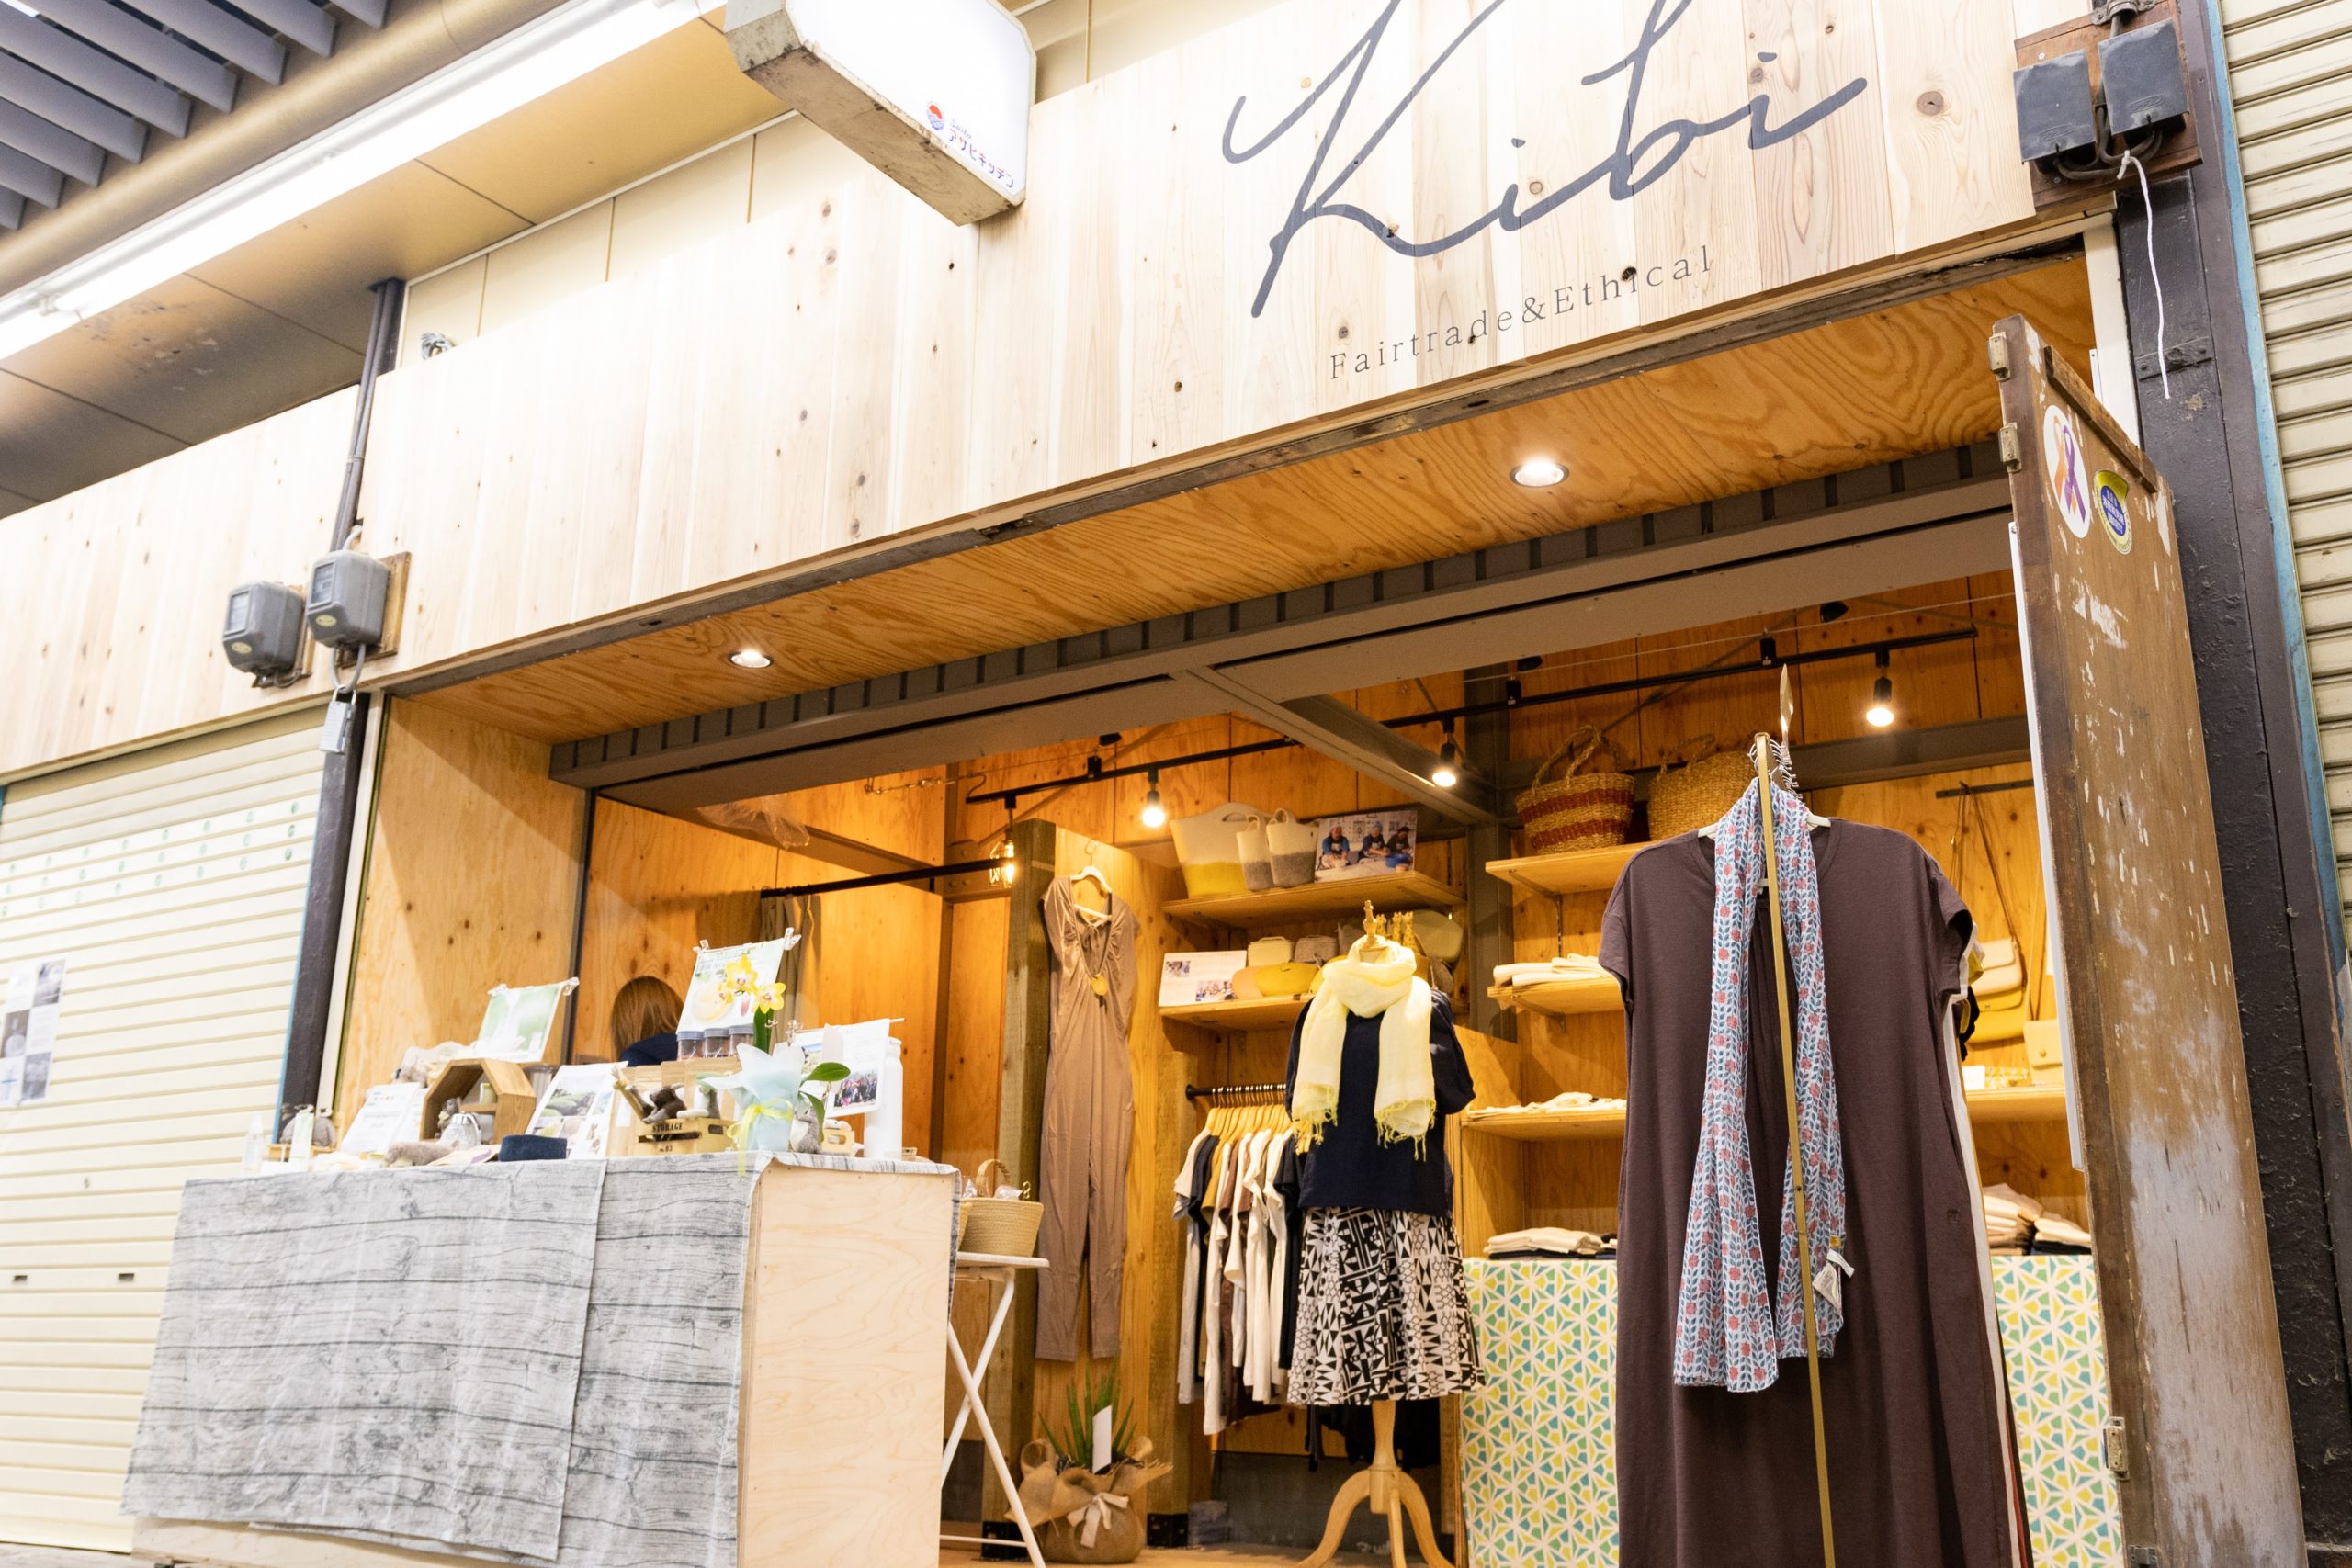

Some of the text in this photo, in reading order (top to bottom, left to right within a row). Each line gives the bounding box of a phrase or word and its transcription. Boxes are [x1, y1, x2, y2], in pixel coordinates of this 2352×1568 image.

[1223, 0, 1867, 317] Kibi
[1329, 245, 1712, 379] Fairtrade&Ethical
[652, 1122, 683, 1133] STORAGE
